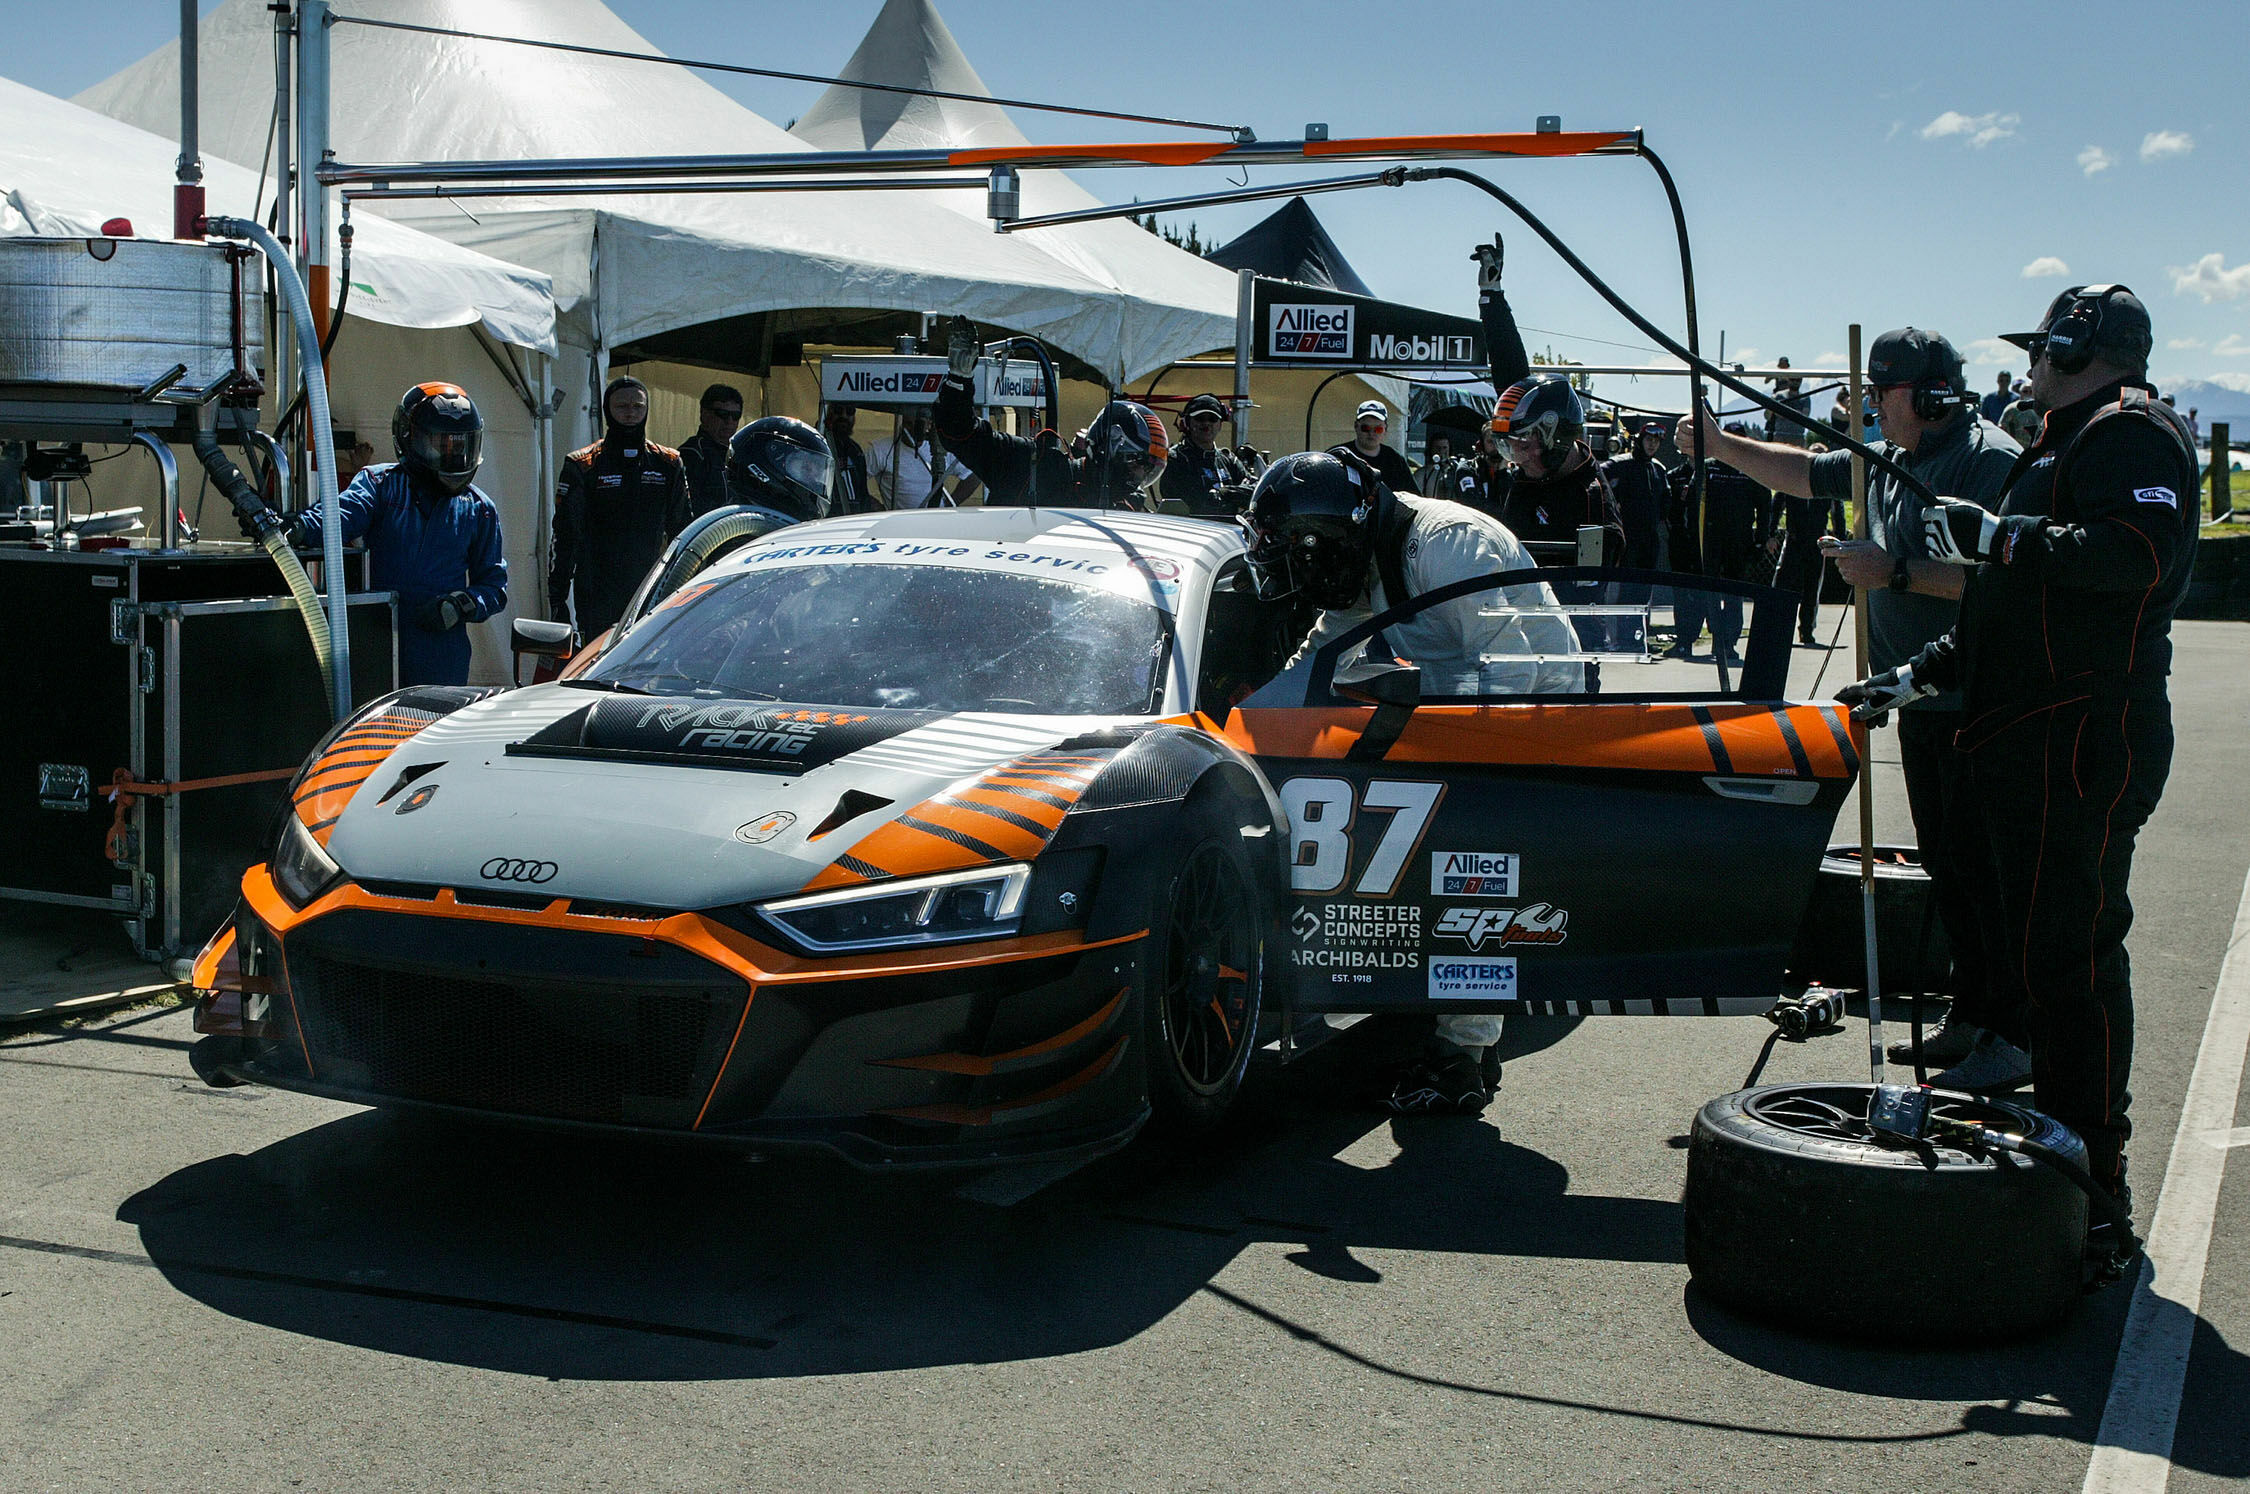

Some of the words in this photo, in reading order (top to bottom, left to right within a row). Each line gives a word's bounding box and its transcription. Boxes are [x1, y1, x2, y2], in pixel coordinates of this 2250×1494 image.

[1276, 308, 1348, 332] Allied
[1280, 336, 1294, 348] 24
[1305, 337, 1312, 348] 7
[1321, 337, 1345, 349] Fuel
[1370, 334, 1444, 361] Mobil
[837, 372, 899, 392] Allied
[906, 378, 919, 388] 24
[928, 378, 937, 388] 7
[743, 542, 886, 564] CARTER'S
[894, 544, 970, 556] tyre
[984, 550, 1109, 574] servic
[1279, 775, 1447, 898] 87
[1444, 854, 1509, 874] Allied
[1447, 880, 1460, 890] 24
[1470, 881, 1477, 890] 7
[1484, 882, 1505, 891] Fuel
[1324, 904, 1421, 921] STREETER
[1324, 921, 1421, 938] CONCEPTS
[1324, 938, 1421, 947] SIGNWRITING
[1292, 949, 1419, 968] ARCHIBALDS
[1331, 974, 1350, 982] EST.
[1353, 974, 1372, 983] 1918
[1432, 963, 1514, 980] CARTER'S
[1438, 981, 1461, 991] tyre
[1465, 982, 1507, 990] service
